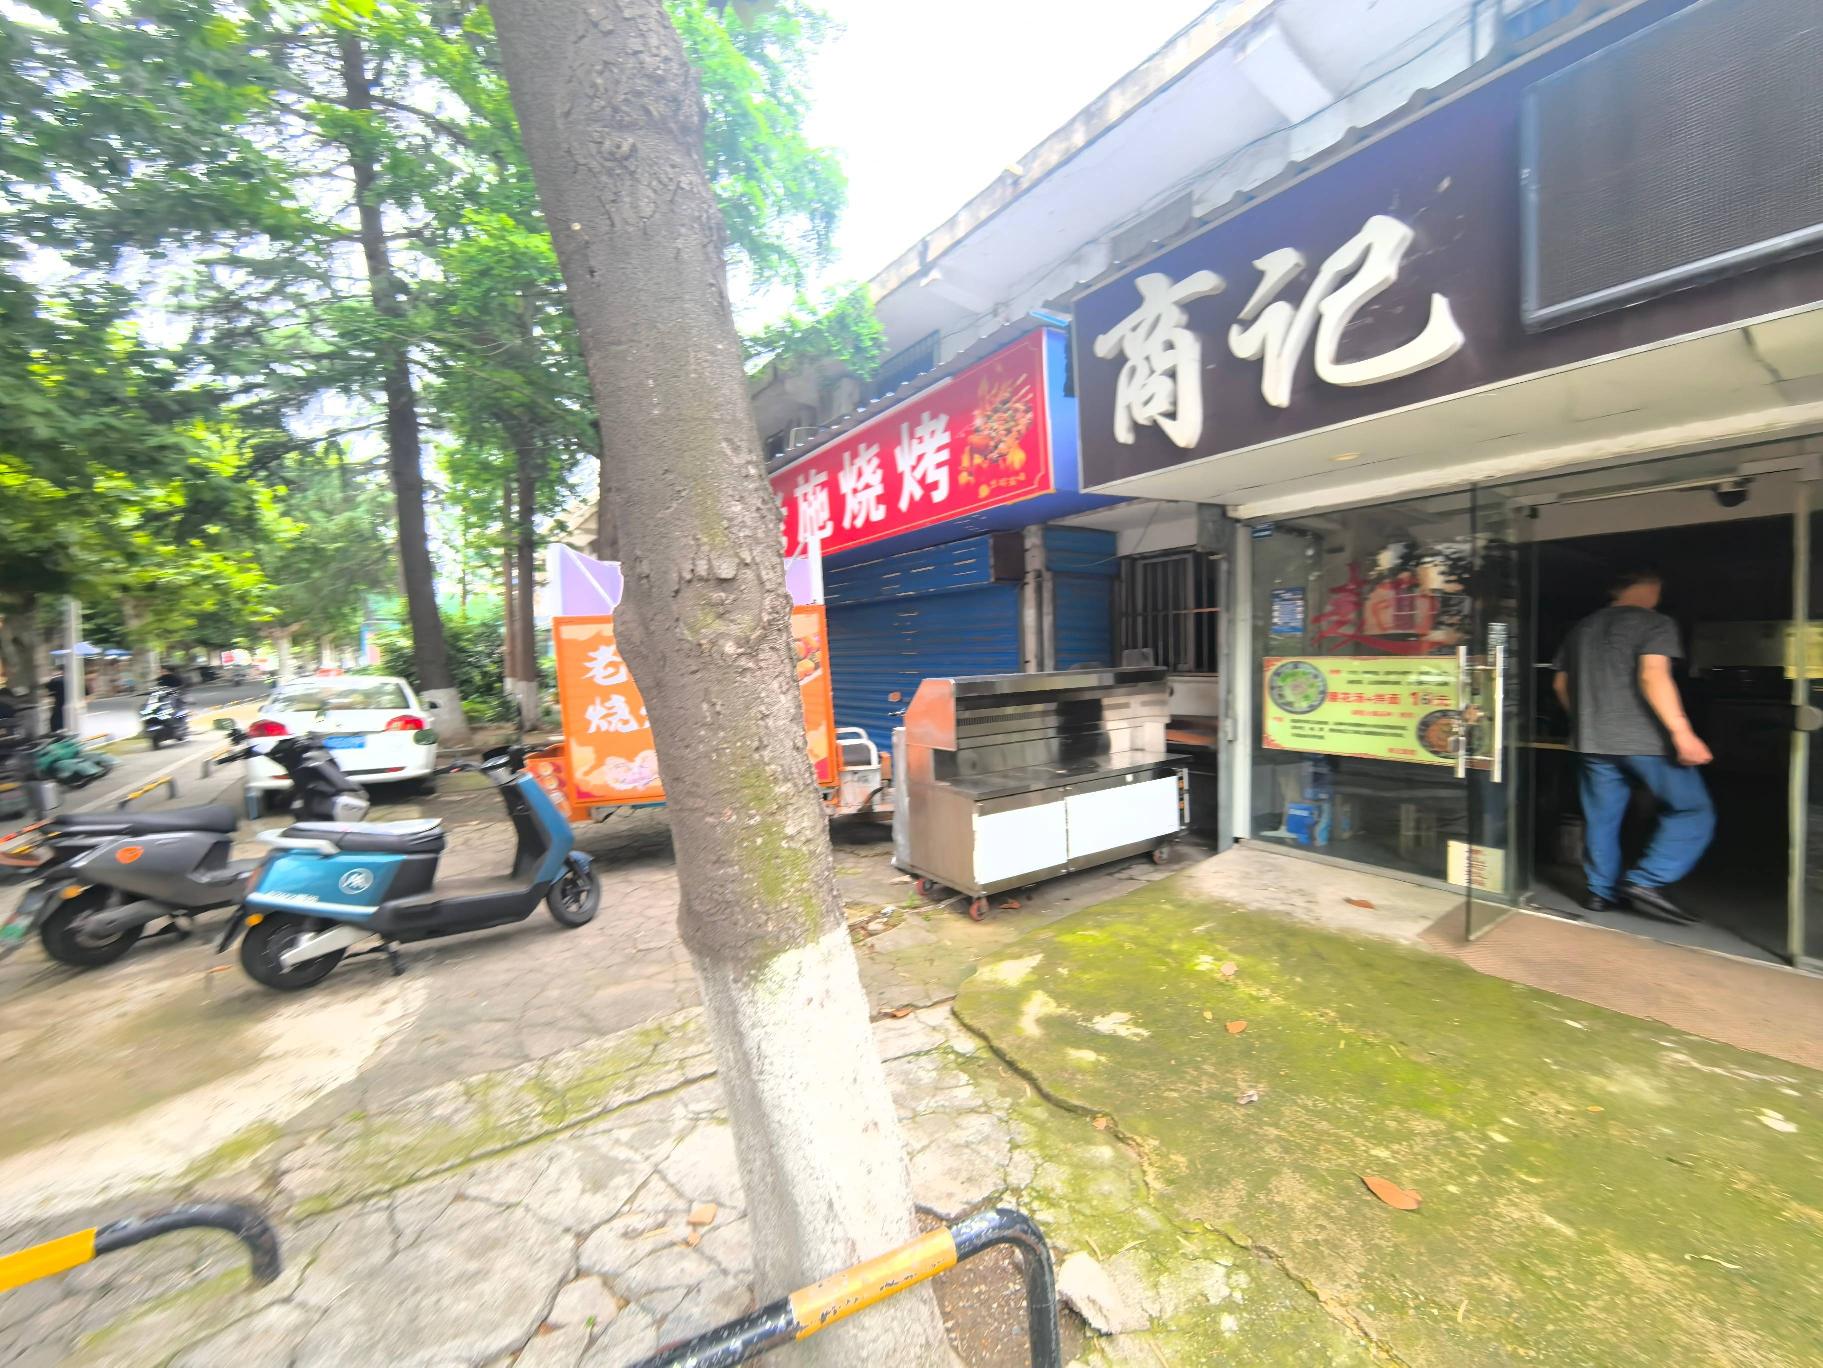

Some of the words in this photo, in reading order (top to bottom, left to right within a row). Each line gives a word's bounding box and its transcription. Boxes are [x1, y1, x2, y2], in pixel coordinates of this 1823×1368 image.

[1094, 214, 1465, 449] 商记
[779, 411, 952, 547] 施烧烤
[585, 694, 651, 733] 烧
